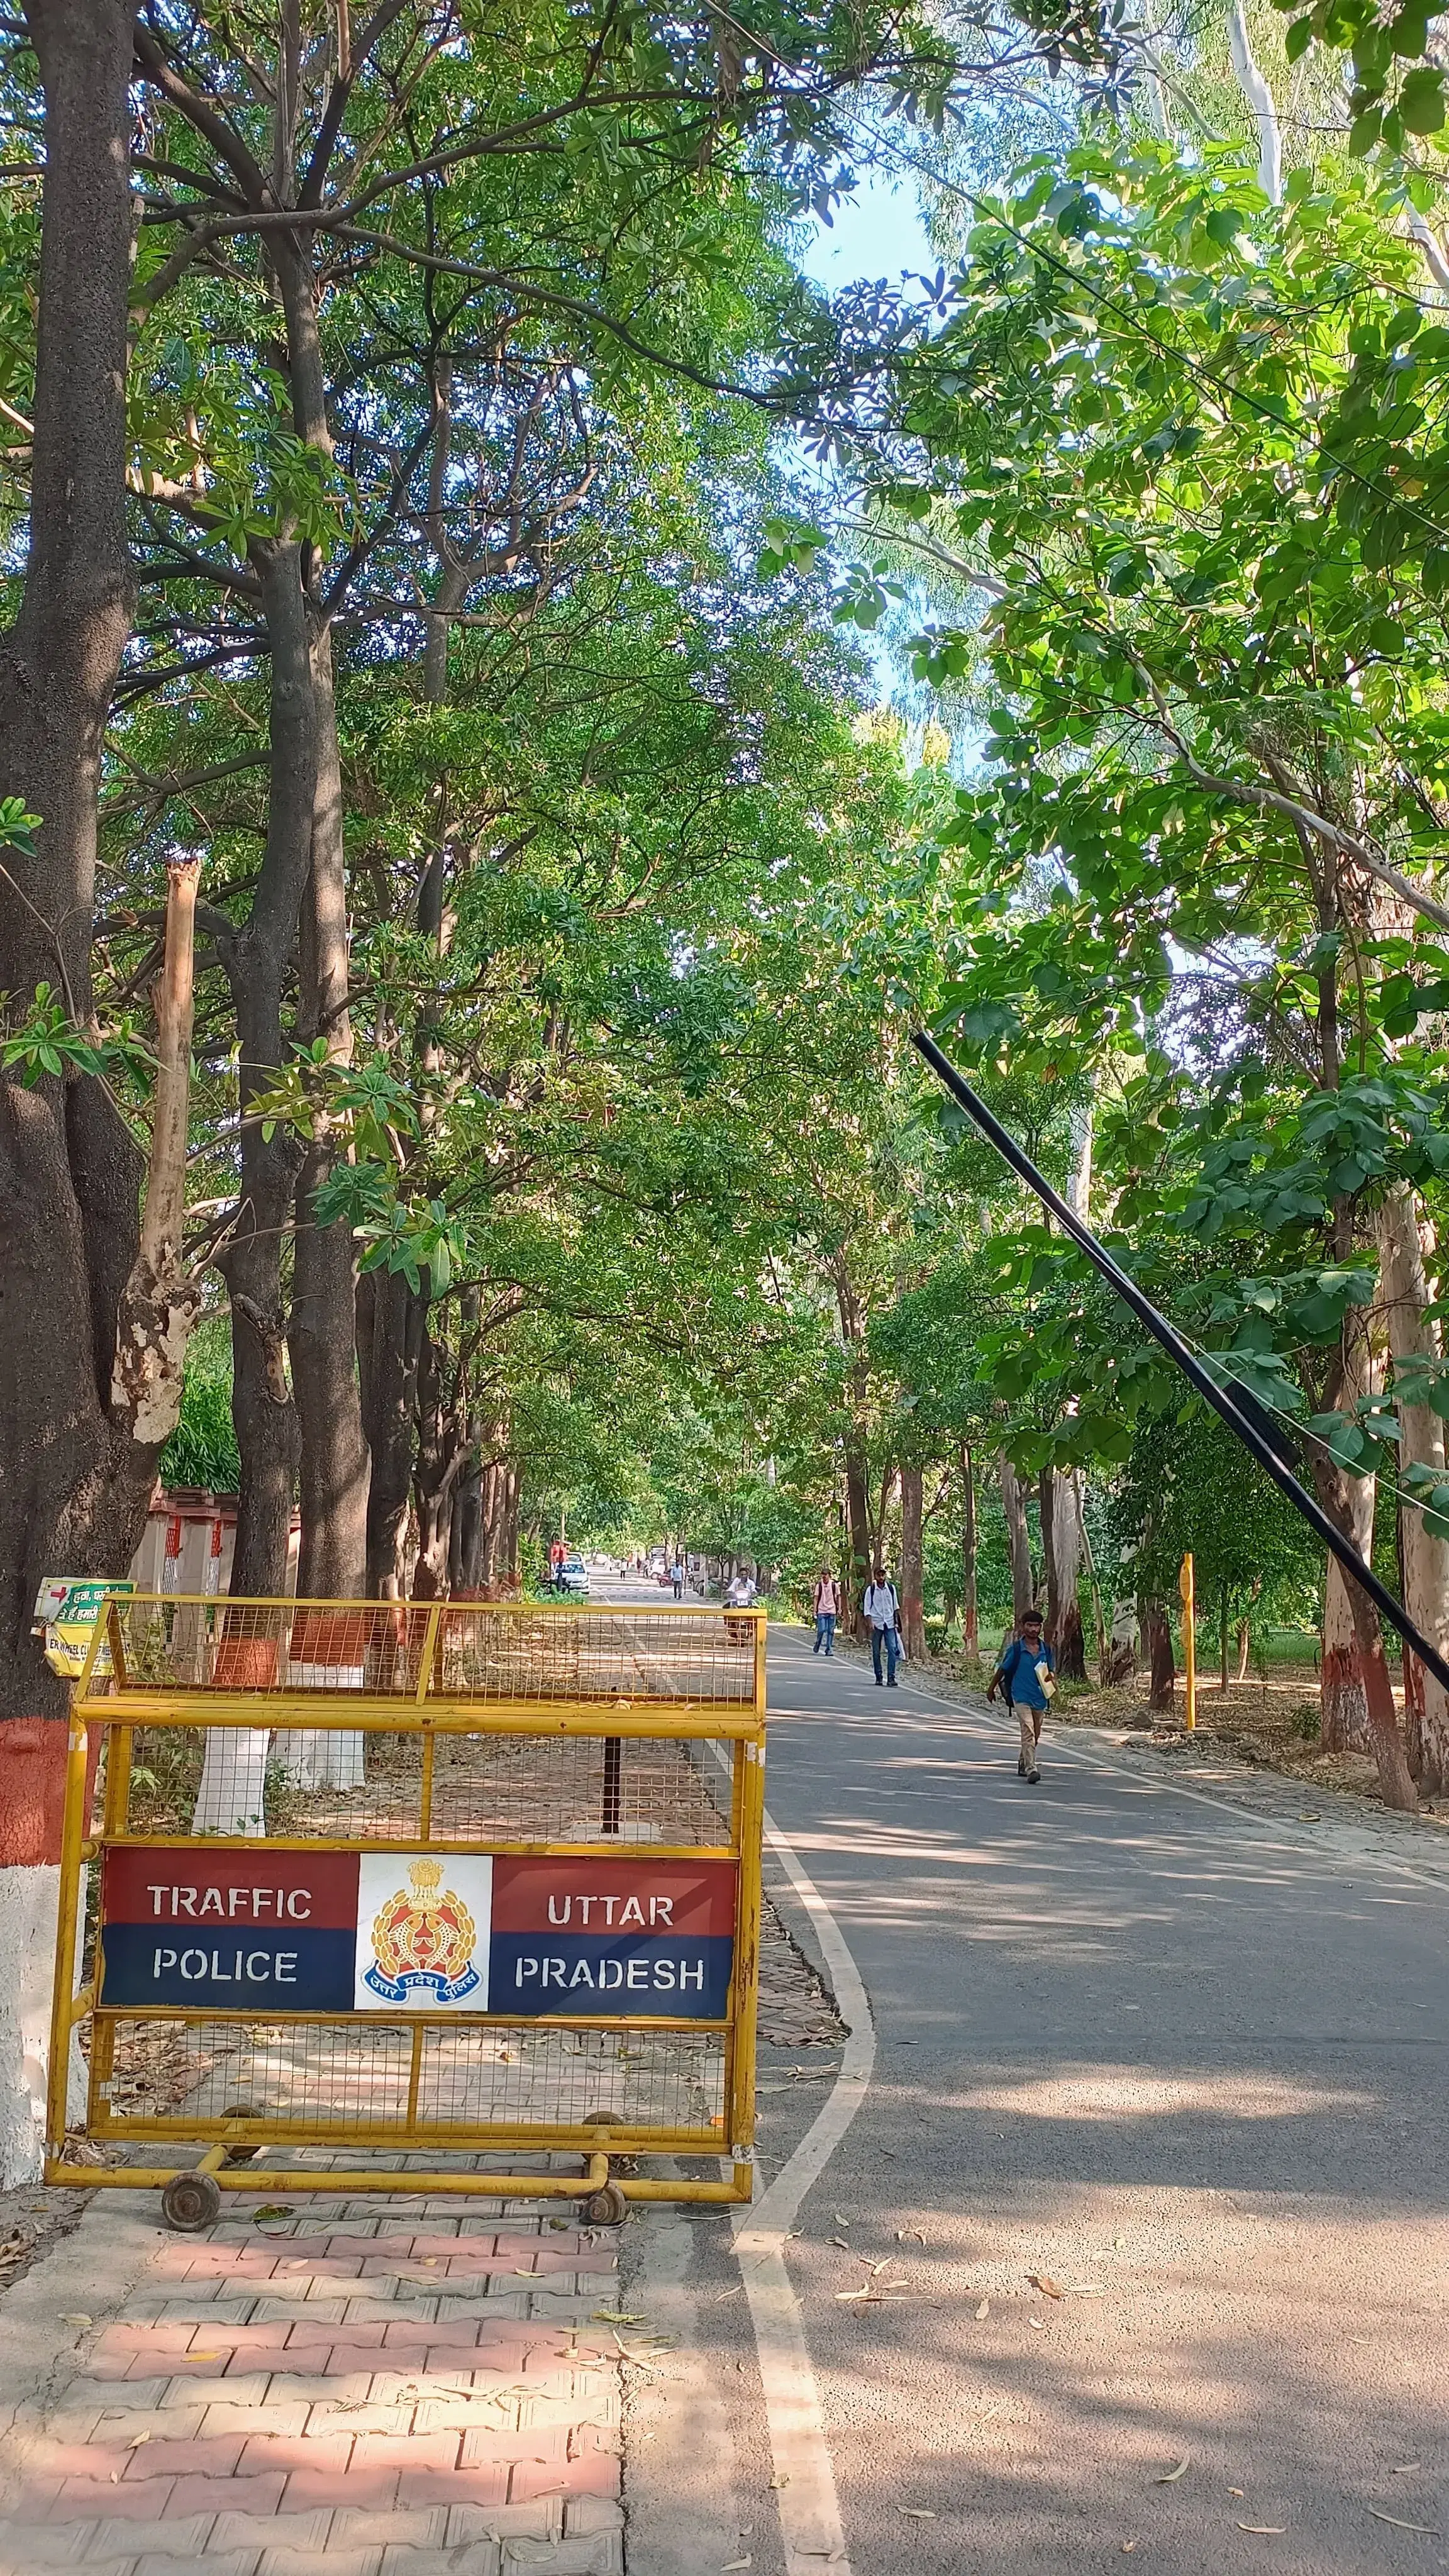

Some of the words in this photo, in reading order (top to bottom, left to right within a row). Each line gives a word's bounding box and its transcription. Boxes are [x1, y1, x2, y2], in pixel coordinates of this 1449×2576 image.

[147, 1885, 311, 1919] TRAFFIC
[548, 1895, 674, 1926] UTTAR
[153, 1948, 297, 1982] POLICE
[516, 1957, 704, 1990] PRADESH
[370, 1975, 398, 1999] उत्तर
[403, 1972, 440, 1988] प्रदेश
[444, 1973, 477, 2001] पुलिस
